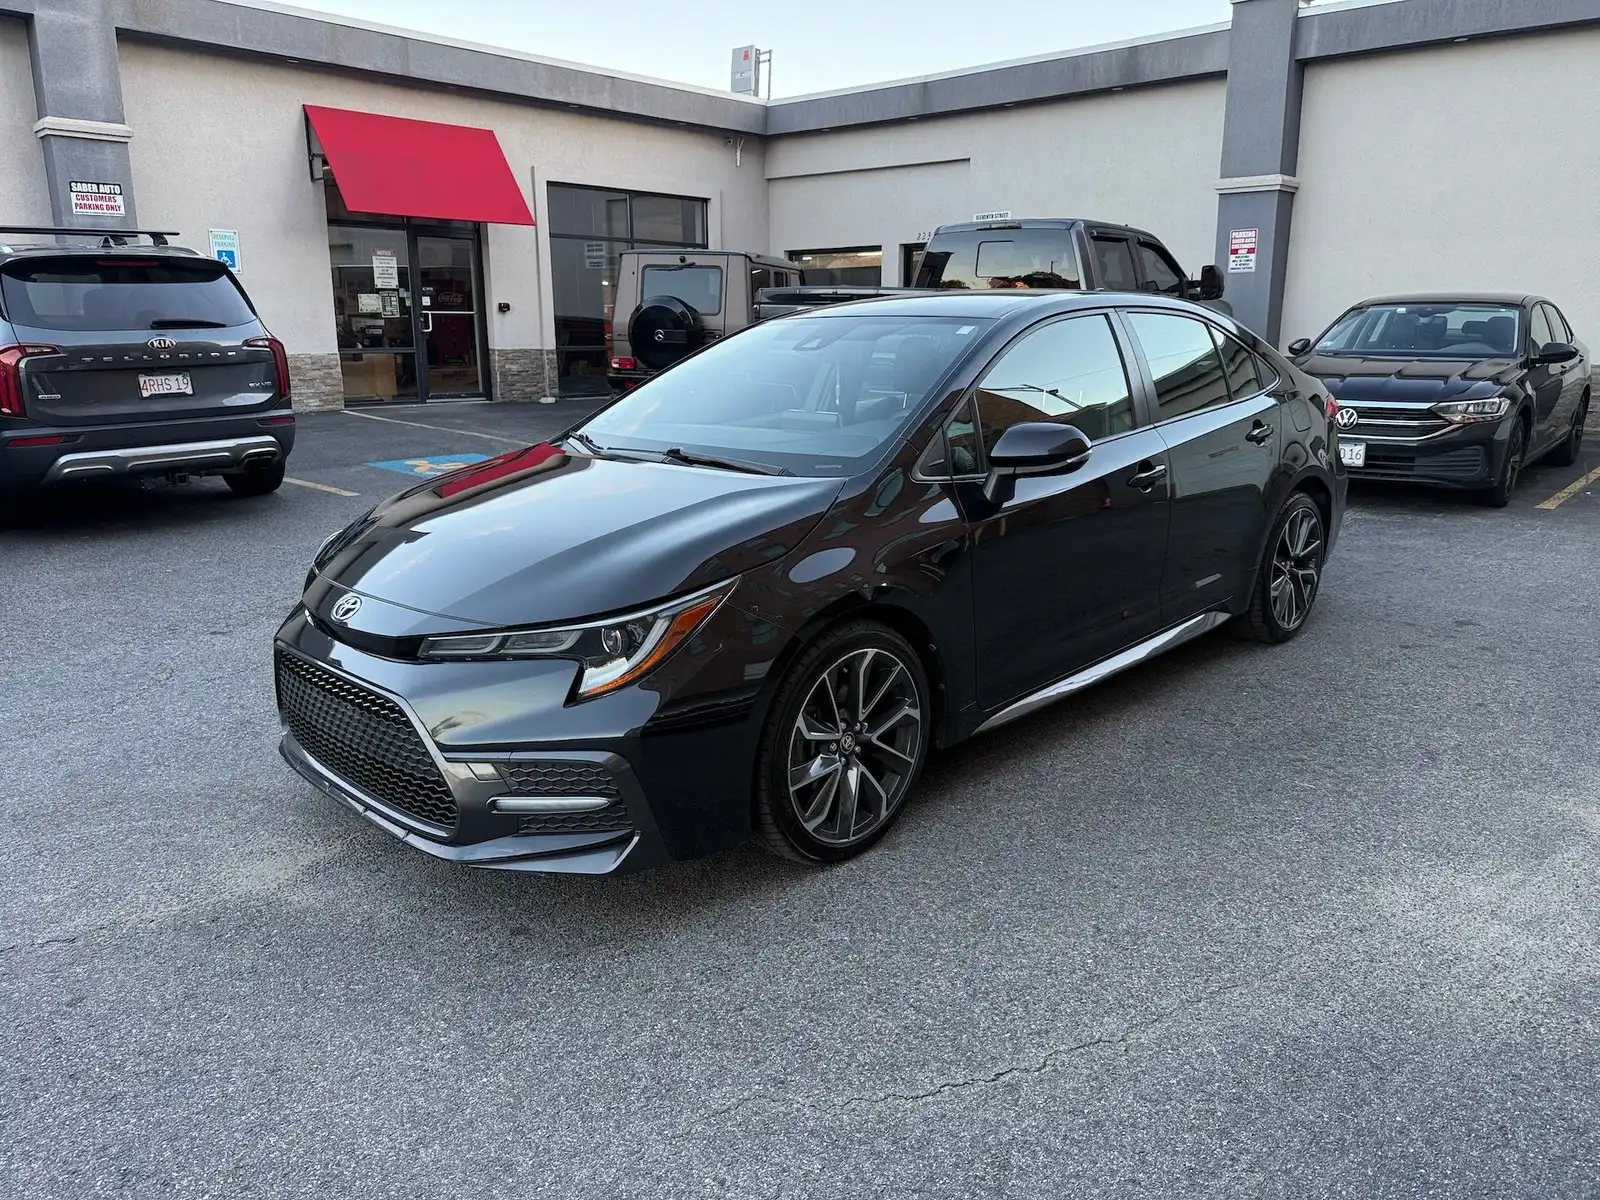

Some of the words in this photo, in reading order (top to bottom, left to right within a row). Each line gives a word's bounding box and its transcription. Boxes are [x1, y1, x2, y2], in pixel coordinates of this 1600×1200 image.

[70, 182, 98, 193] SABER
[99, 184, 121, 195] AUTO
[75, 193, 117, 203] CUSTOMERS
[74, 202, 105, 211] PARKING
[105, 204, 122, 212] ONLY
[213, 232, 236, 241] RESERVED
[1232, 230, 1256, 239] PARKING
[214, 240, 236, 248] PARKING
[152, 339, 173, 349] KIA
[141, 378, 172, 392] 4RHS
[176, 377, 189, 390] 19
[1348, 448, 1362, 460] 16
